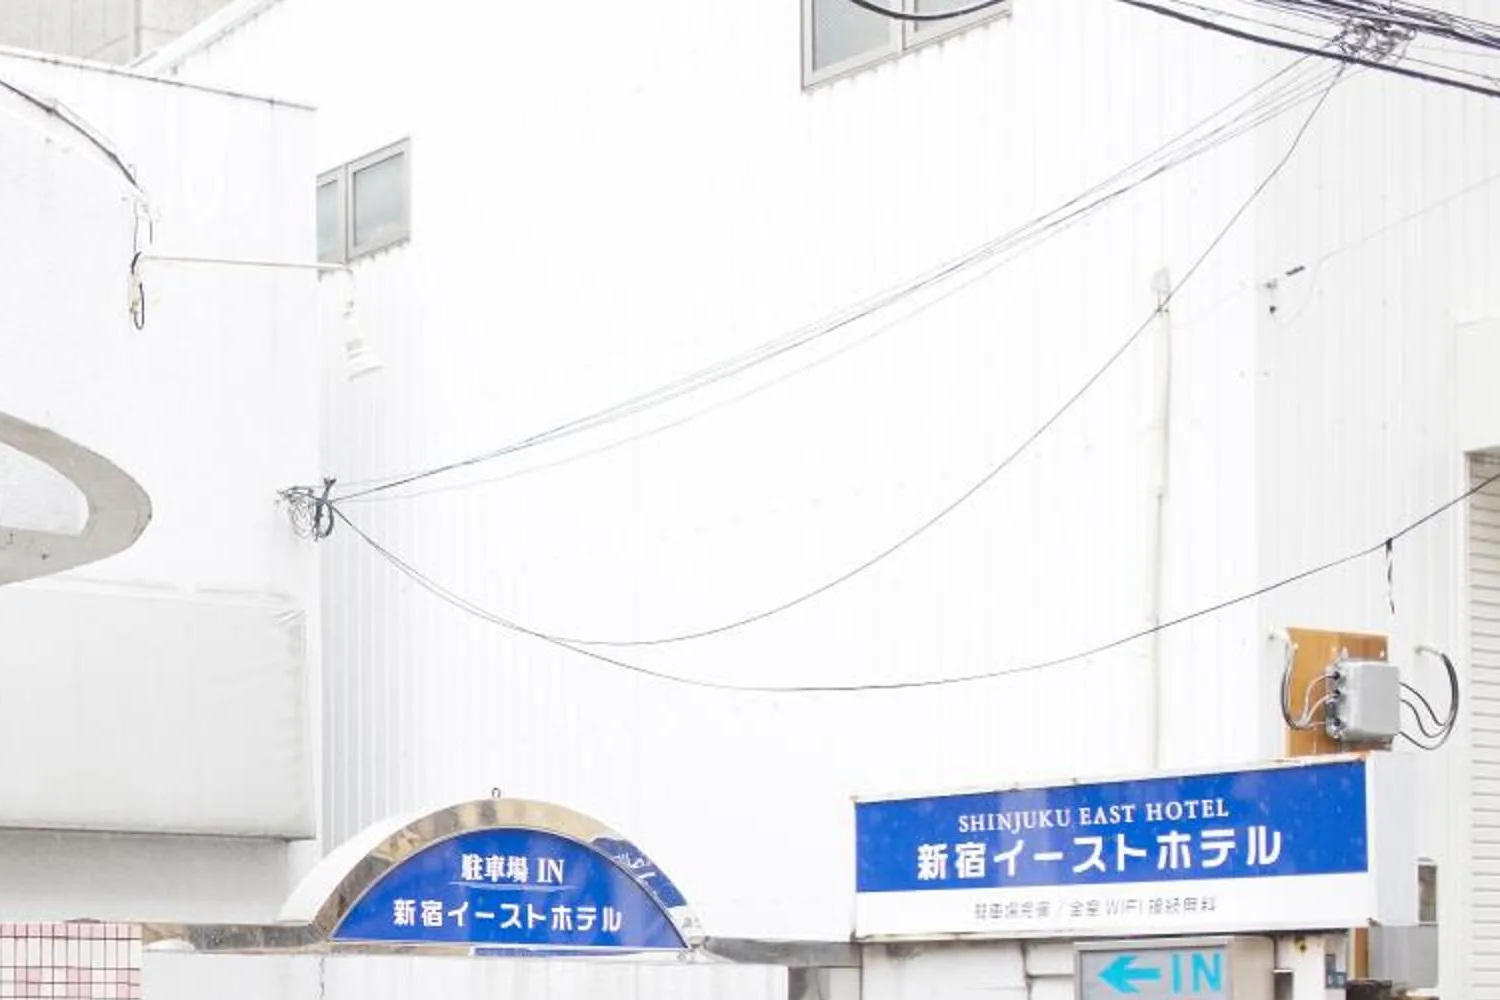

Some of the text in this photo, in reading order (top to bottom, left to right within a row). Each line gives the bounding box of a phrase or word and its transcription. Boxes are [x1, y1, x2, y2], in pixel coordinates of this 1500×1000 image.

[958, 798, 1230, 835] SHINJUKU EAST HOTEL
[461, 853, 566, 883] 駐車場 IN
[916, 825, 1283, 882] 新宿イーストホテル
[392, 898, 623, 932] 新宿イーストホテル
[1171, 952, 1222, 993] IN
